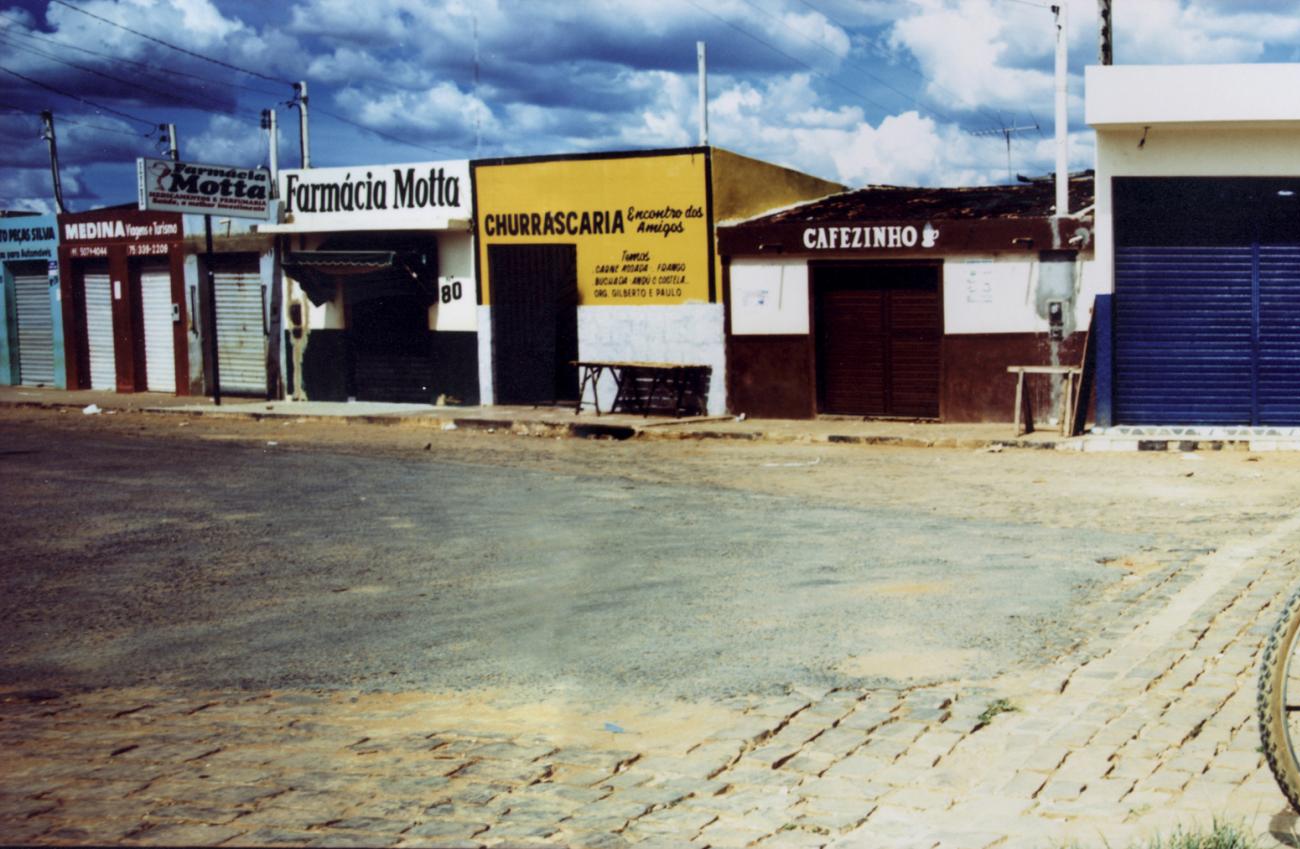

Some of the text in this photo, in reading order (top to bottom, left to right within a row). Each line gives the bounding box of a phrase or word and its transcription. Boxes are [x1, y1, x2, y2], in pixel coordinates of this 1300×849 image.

[173, 163, 266, 182] Farmácia
[168, 173, 266, 200] Motta
[284, 167, 461, 213] Farmácia Motta
[484, 209, 625, 236] CHURRASCARIA
[627, 205, 704, 222] Encontro dos
[32, 226, 55, 241] SILVA
[65, 220, 125, 240] MEDINA
[637, 220, 684, 238] Amigos
[803, 225, 917, 249] CAFEZINHO
[441, 281, 462, 304] 80
[611, 287, 647, 298] GILBERTO
[649, 288, 654, 298] E
[656, 287, 682, 297] PAULO
